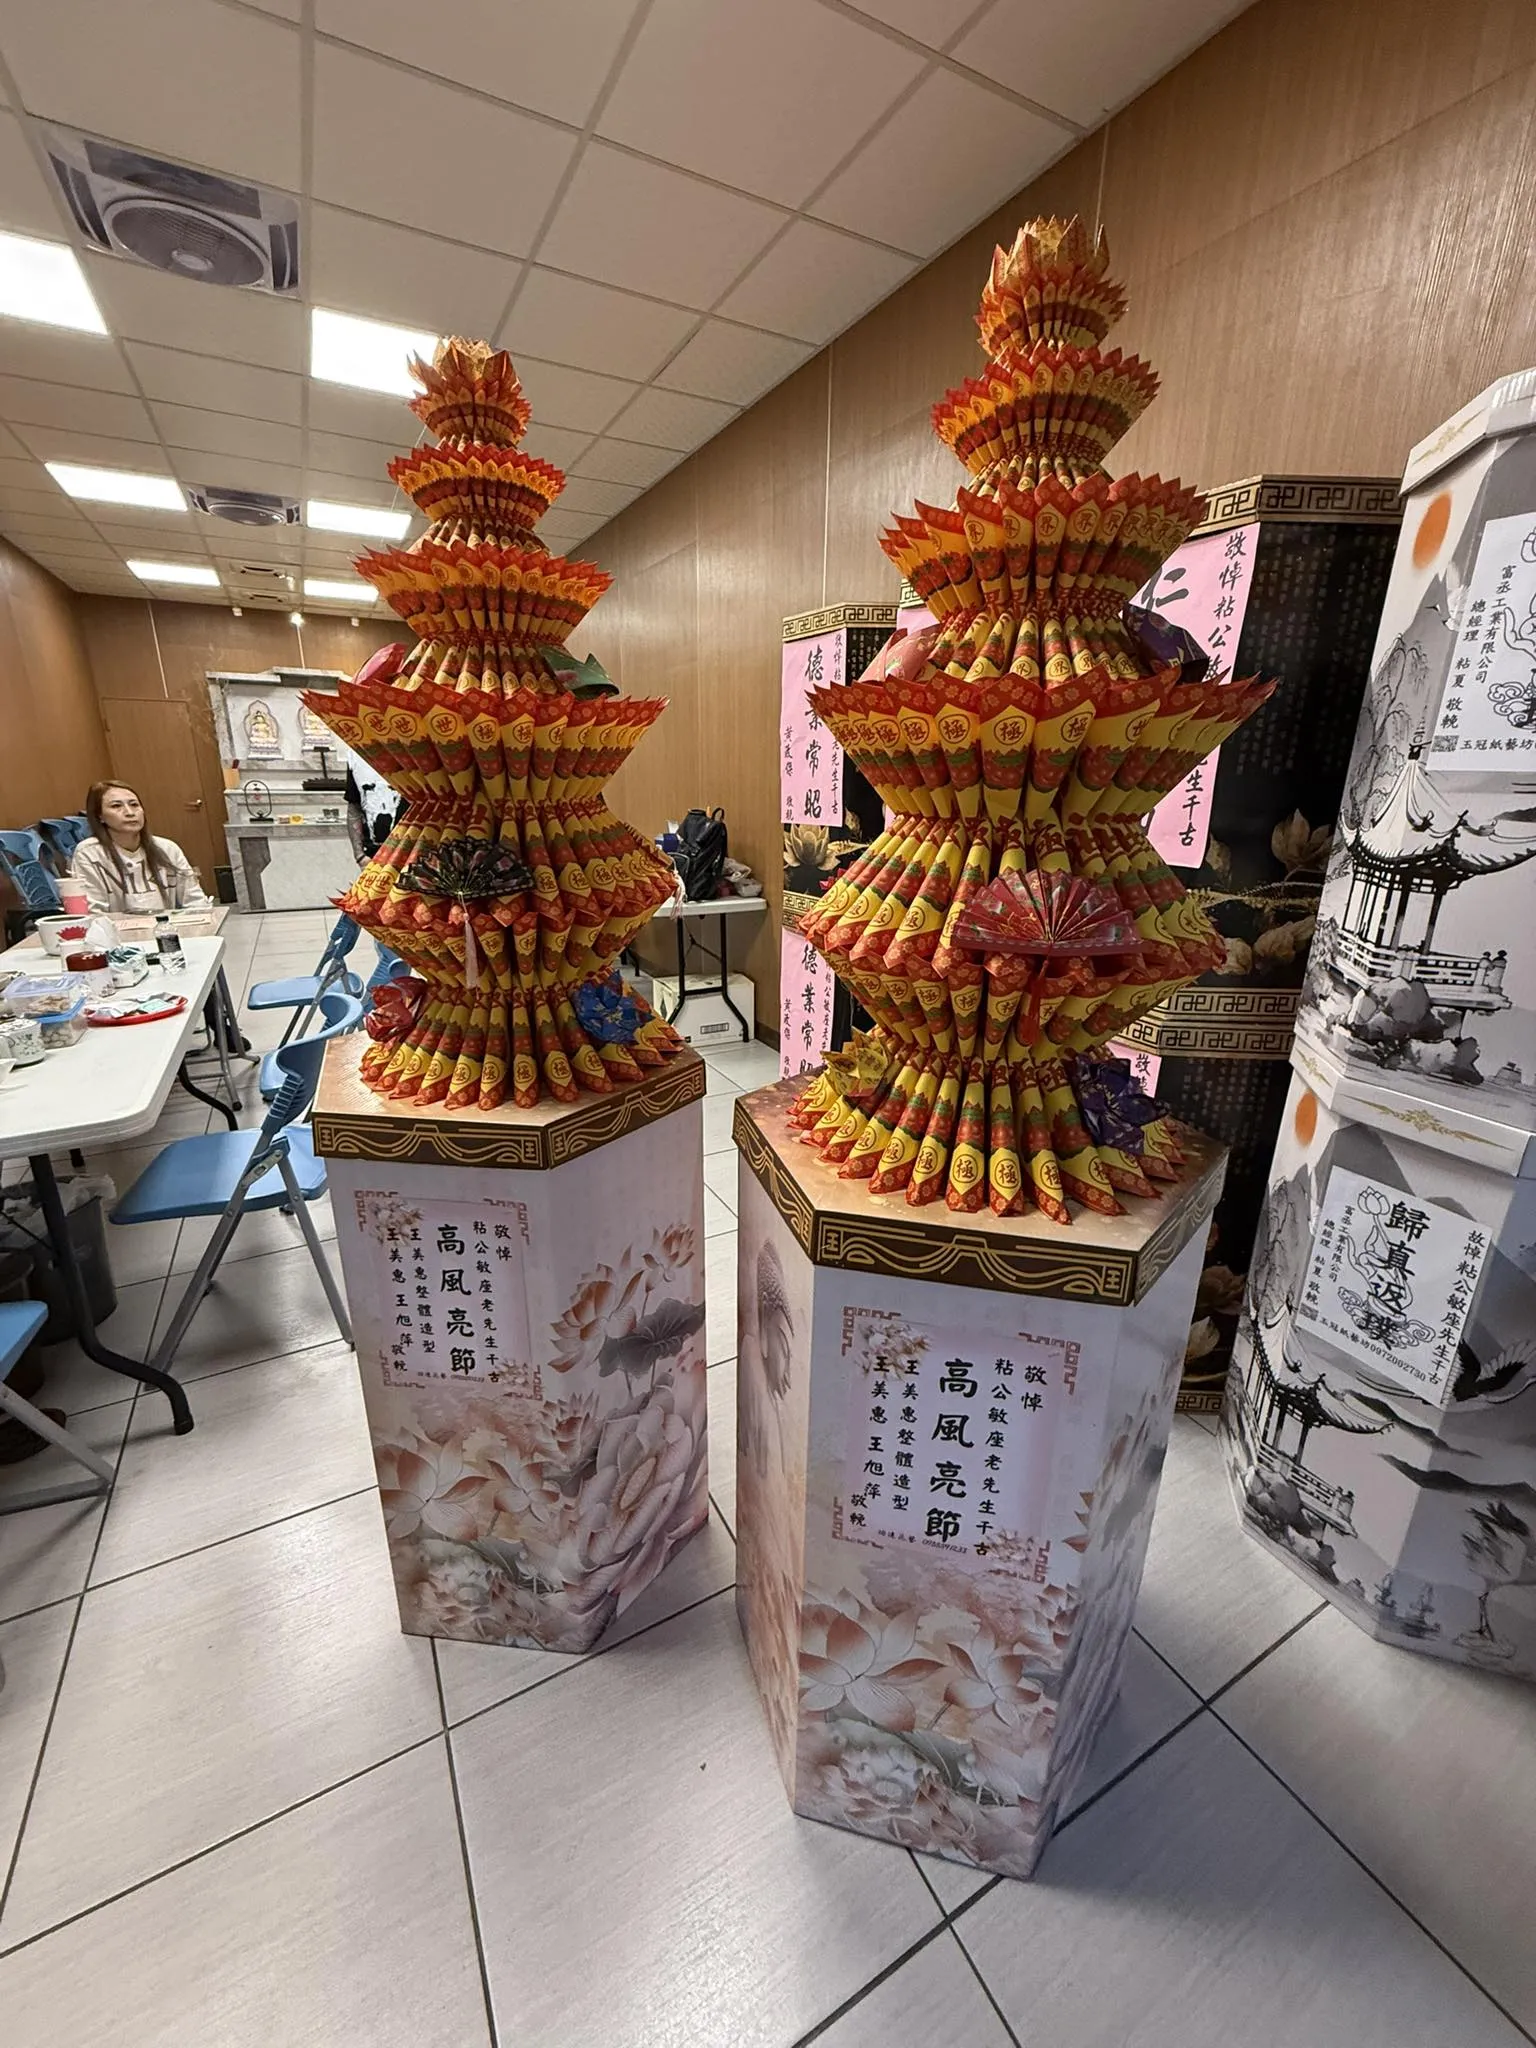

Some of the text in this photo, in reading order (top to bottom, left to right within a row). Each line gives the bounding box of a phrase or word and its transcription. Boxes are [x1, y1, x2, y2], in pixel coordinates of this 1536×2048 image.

[1463, 600, 1486, 642] 總經理
[494, 1224, 512, 1261] 敬悼
[437, 1224, 476, 1376] 高風亮節
[1021, 1365, 1047, 1412] 敬悼
[925, 1358, 978, 1542] 高風亮節
